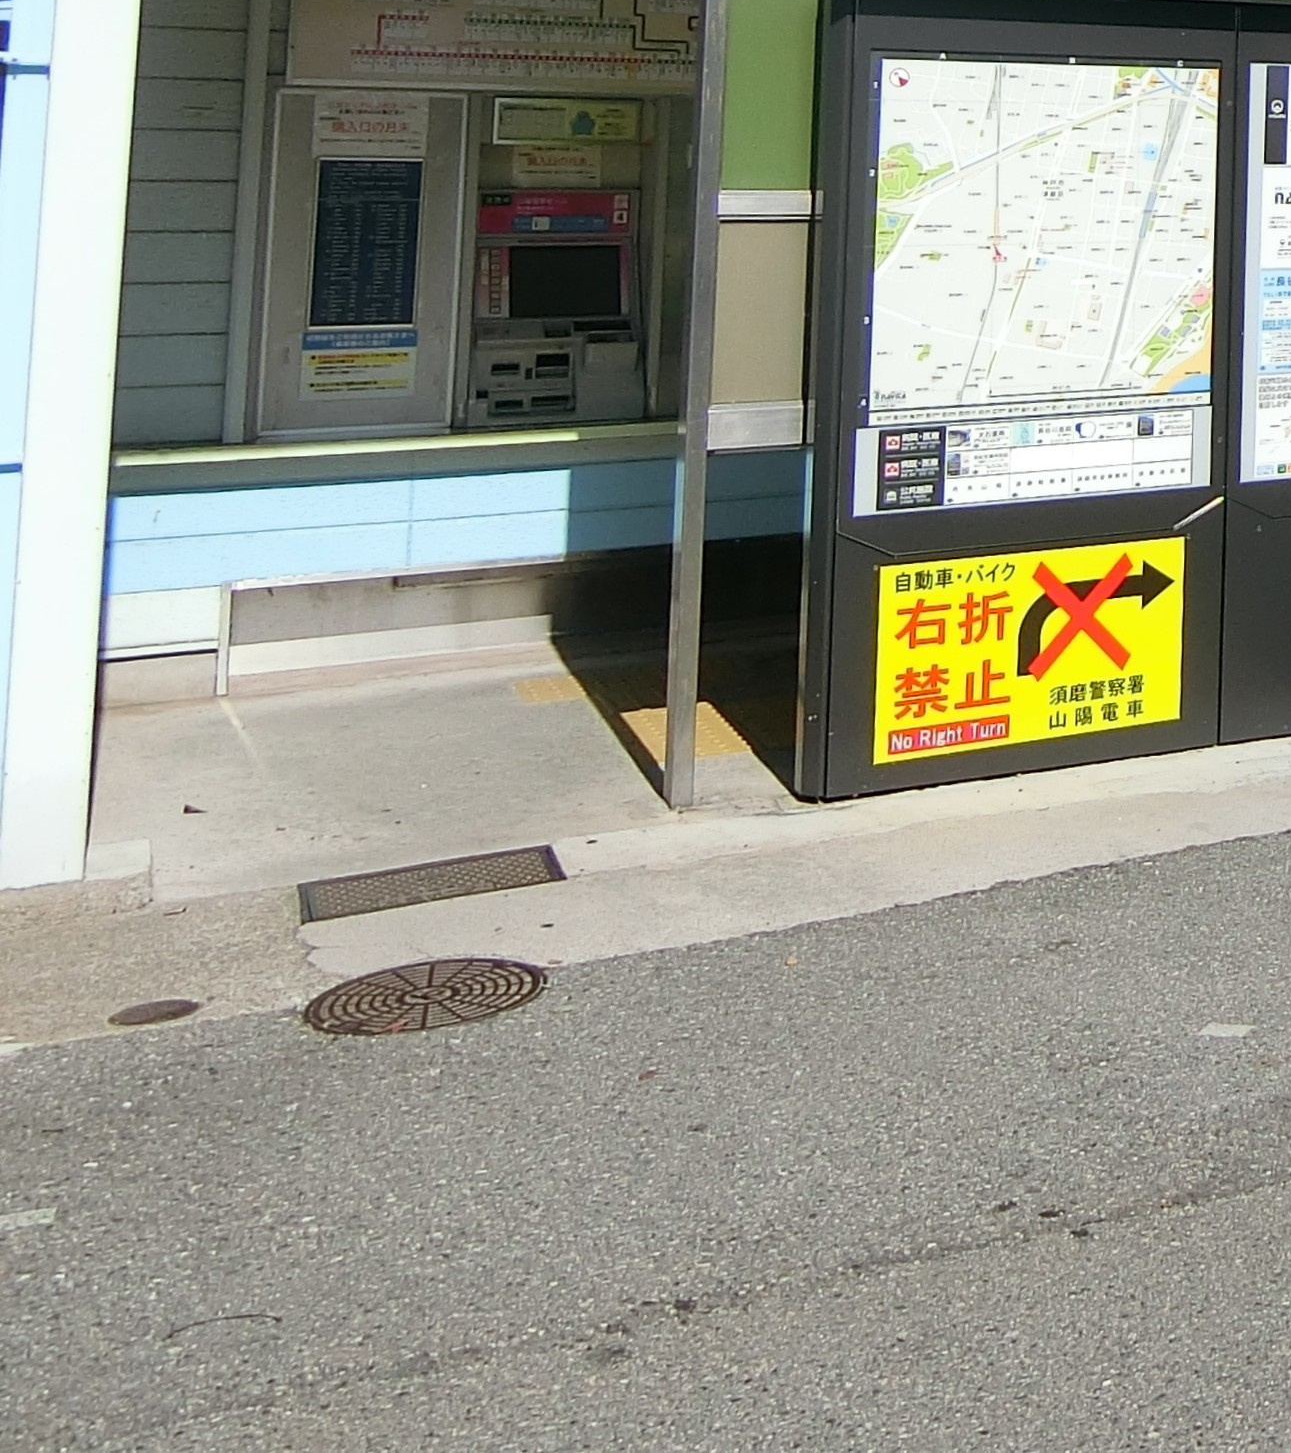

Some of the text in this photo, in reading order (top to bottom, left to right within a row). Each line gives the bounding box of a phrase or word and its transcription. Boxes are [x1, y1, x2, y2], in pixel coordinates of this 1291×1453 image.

[895, 561, 1016, 594] 自動車・バイク
[895, 591, 1013, 649] 右折
[894, 659, 1011, 720] 禁止
[1049, 674, 1145, 705] 須磨警察署
[1049, 699, 1144, 730] 山陽電車
[890, 720, 1006, 752] No Right Turn
